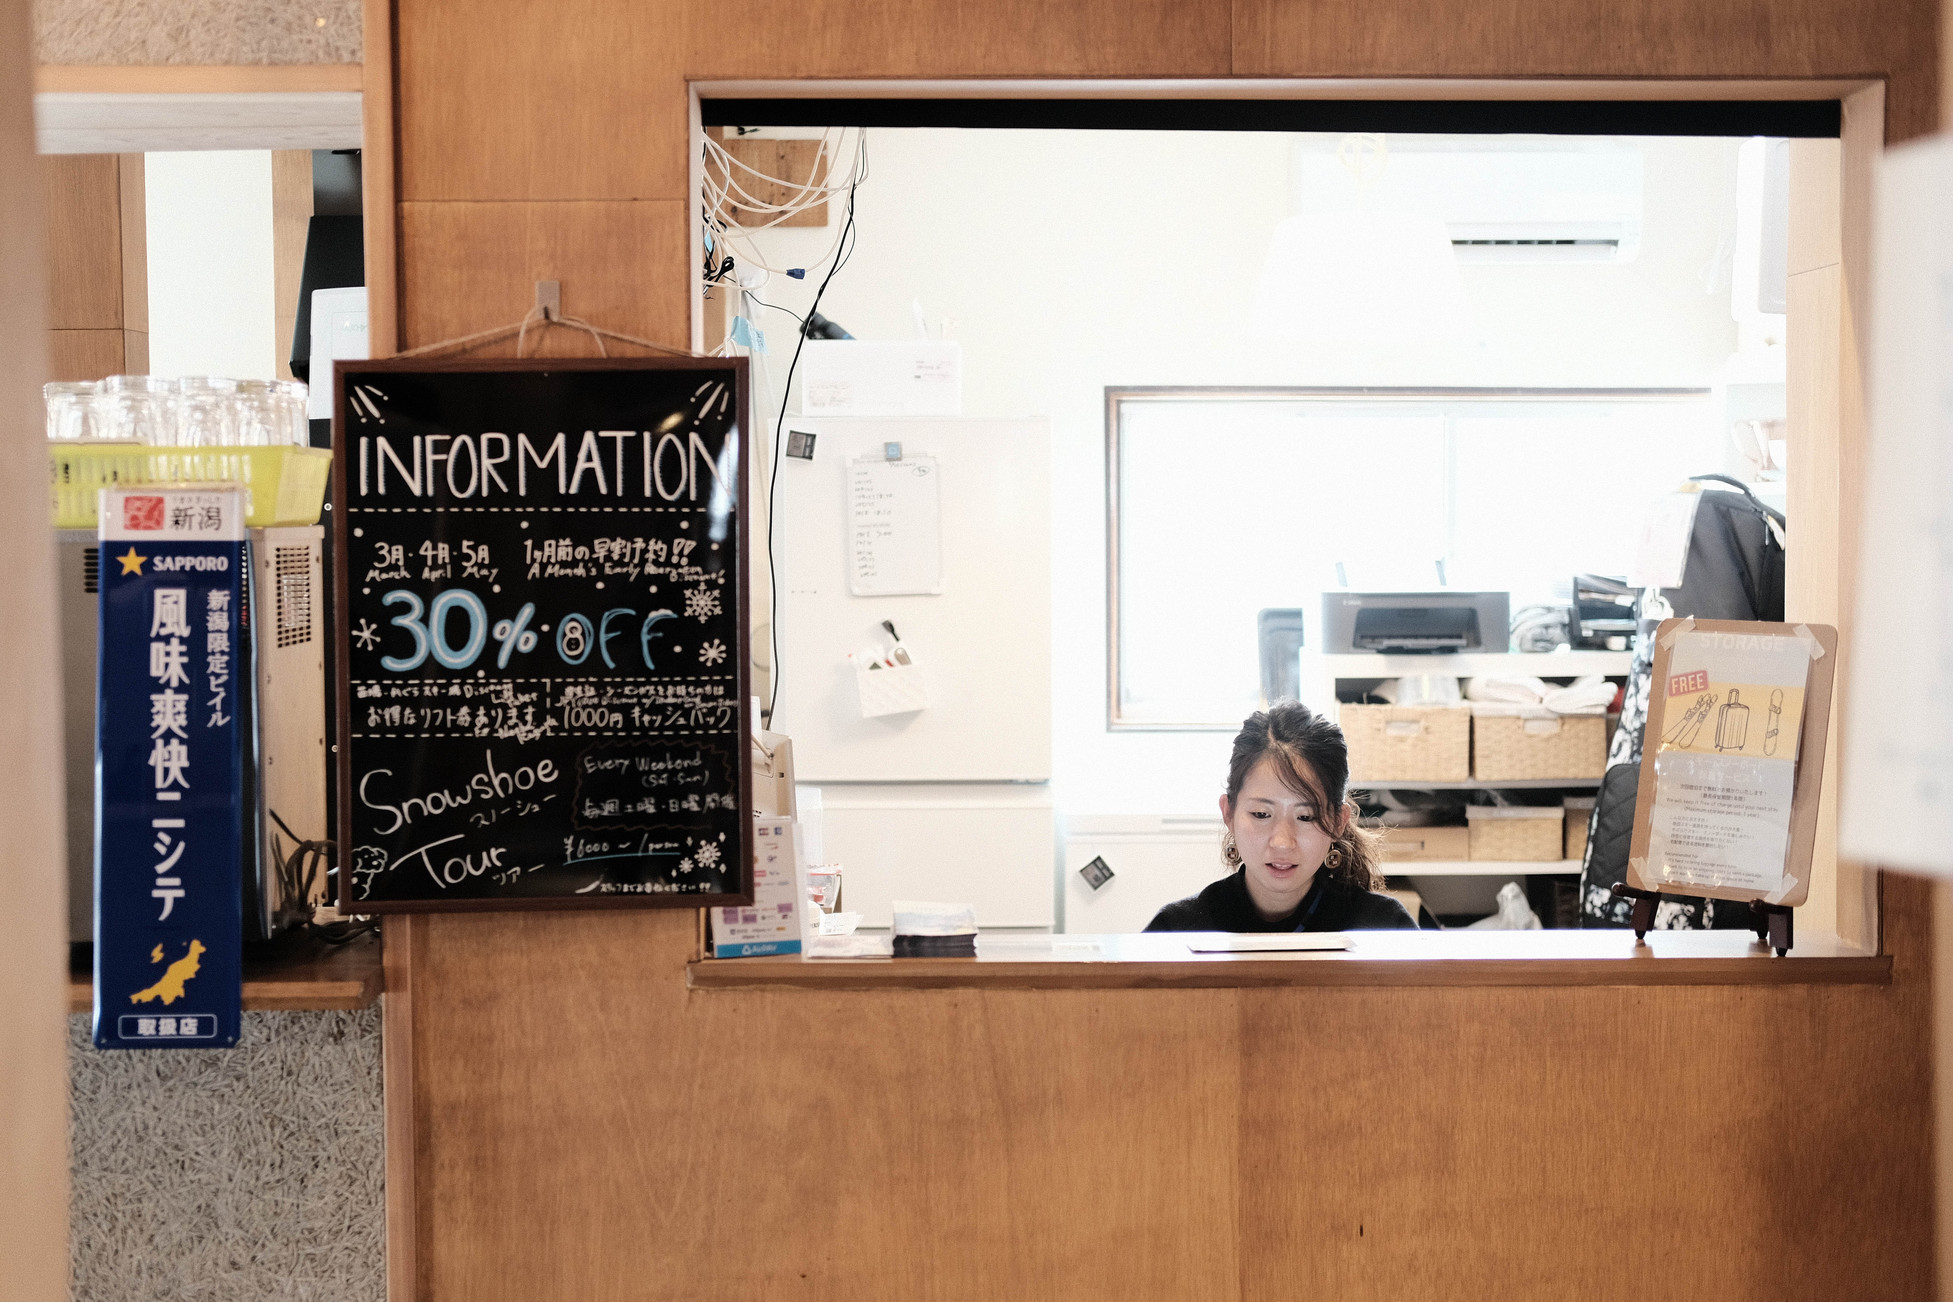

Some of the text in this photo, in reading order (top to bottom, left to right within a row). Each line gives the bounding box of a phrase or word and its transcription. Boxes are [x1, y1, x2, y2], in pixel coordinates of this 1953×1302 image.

[358, 430, 731, 501] INFORMATION
[169, 506, 222, 531] 新潟
[152, 556, 229, 571] SAPPORO
[365, 565, 412, 582] March
[461, 566, 499, 583] May
[527, 563, 541, 580] A
[381, 588, 679, 672] 30% OFF
[1700, 634, 1784, 650] STORAGE
[206, 588, 231, 728] 新潟限定ビイル
[1671, 672, 1705, 694] FREE
[563, 705, 623, 729] 1000円
[148, 588, 192, 921] 風味爽快ニシテ
[583, 751, 702, 775] Every Weekend
[359, 748, 559, 835] Snowshoe
[389, 834, 507, 889] Tour
[491, 864, 545, 886] ツアー
[136, 1017, 198, 1036] 取扱店
